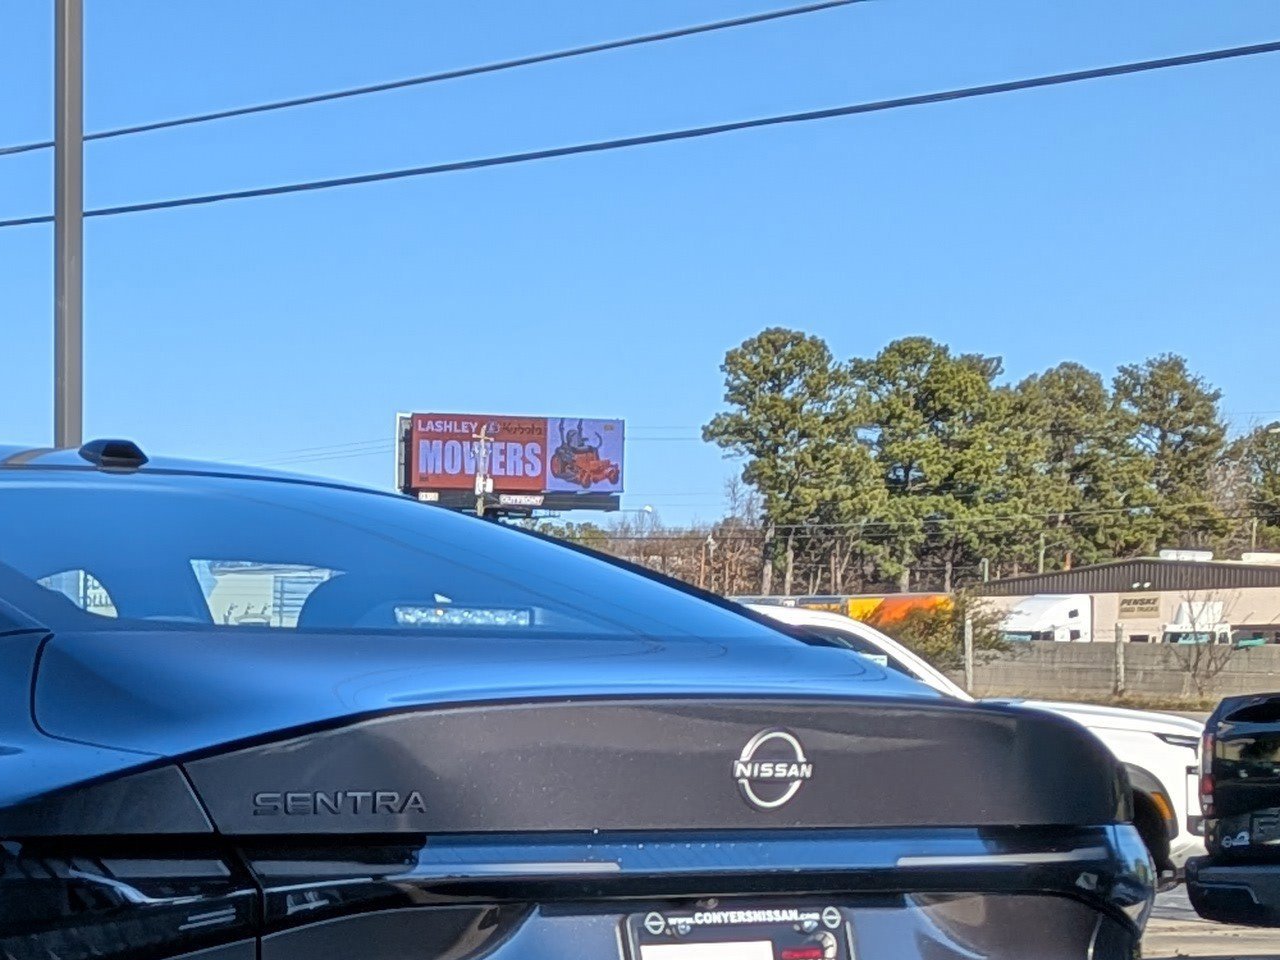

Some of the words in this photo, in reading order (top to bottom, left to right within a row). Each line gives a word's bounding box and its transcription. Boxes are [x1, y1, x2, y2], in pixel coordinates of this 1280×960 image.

[418, 420, 478, 434] LASHLEY
[419, 439, 542, 477] MOWERS
[734, 759, 813, 780] NISSAN
[253, 791, 428, 815] SENTRA
[667, 909, 820, 926] www.CONYERSNISSAN.com
